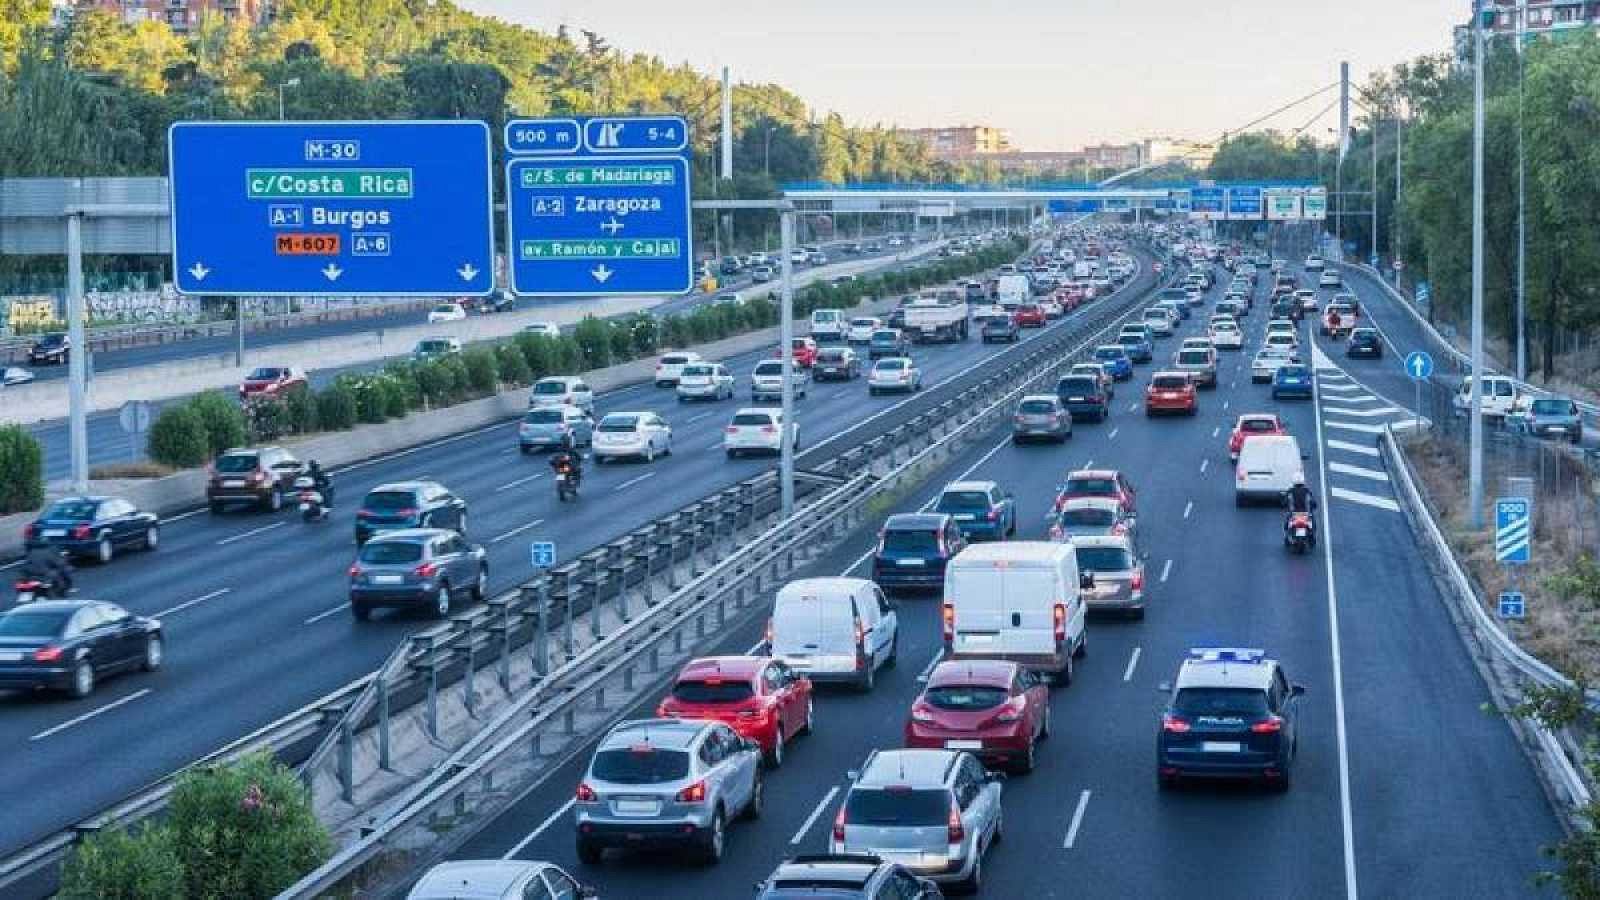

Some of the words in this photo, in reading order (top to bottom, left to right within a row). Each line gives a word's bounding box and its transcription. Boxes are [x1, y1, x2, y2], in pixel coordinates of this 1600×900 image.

[516, 129, 547, 143] 500
[556, 130, 569, 142] m
[308, 143, 355, 158] M-30
[251, 175, 344, 193] c/Costa
[360, 175, 409, 193] Rica
[565, 168, 585, 182] de
[591, 168, 673, 184] Madariaga
[575, 195, 661, 215] Zaragoza
[273, 209, 301, 223] A-1
[312, 207, 390, 229] Burgos
[279, 237, 337, 251] M-607
[356, 237, 385, 251] A-6
[552, 239, 606, 255] Ramón
[613, 244, 622, 257] y
[632, 241, 674, 257] Cajal
